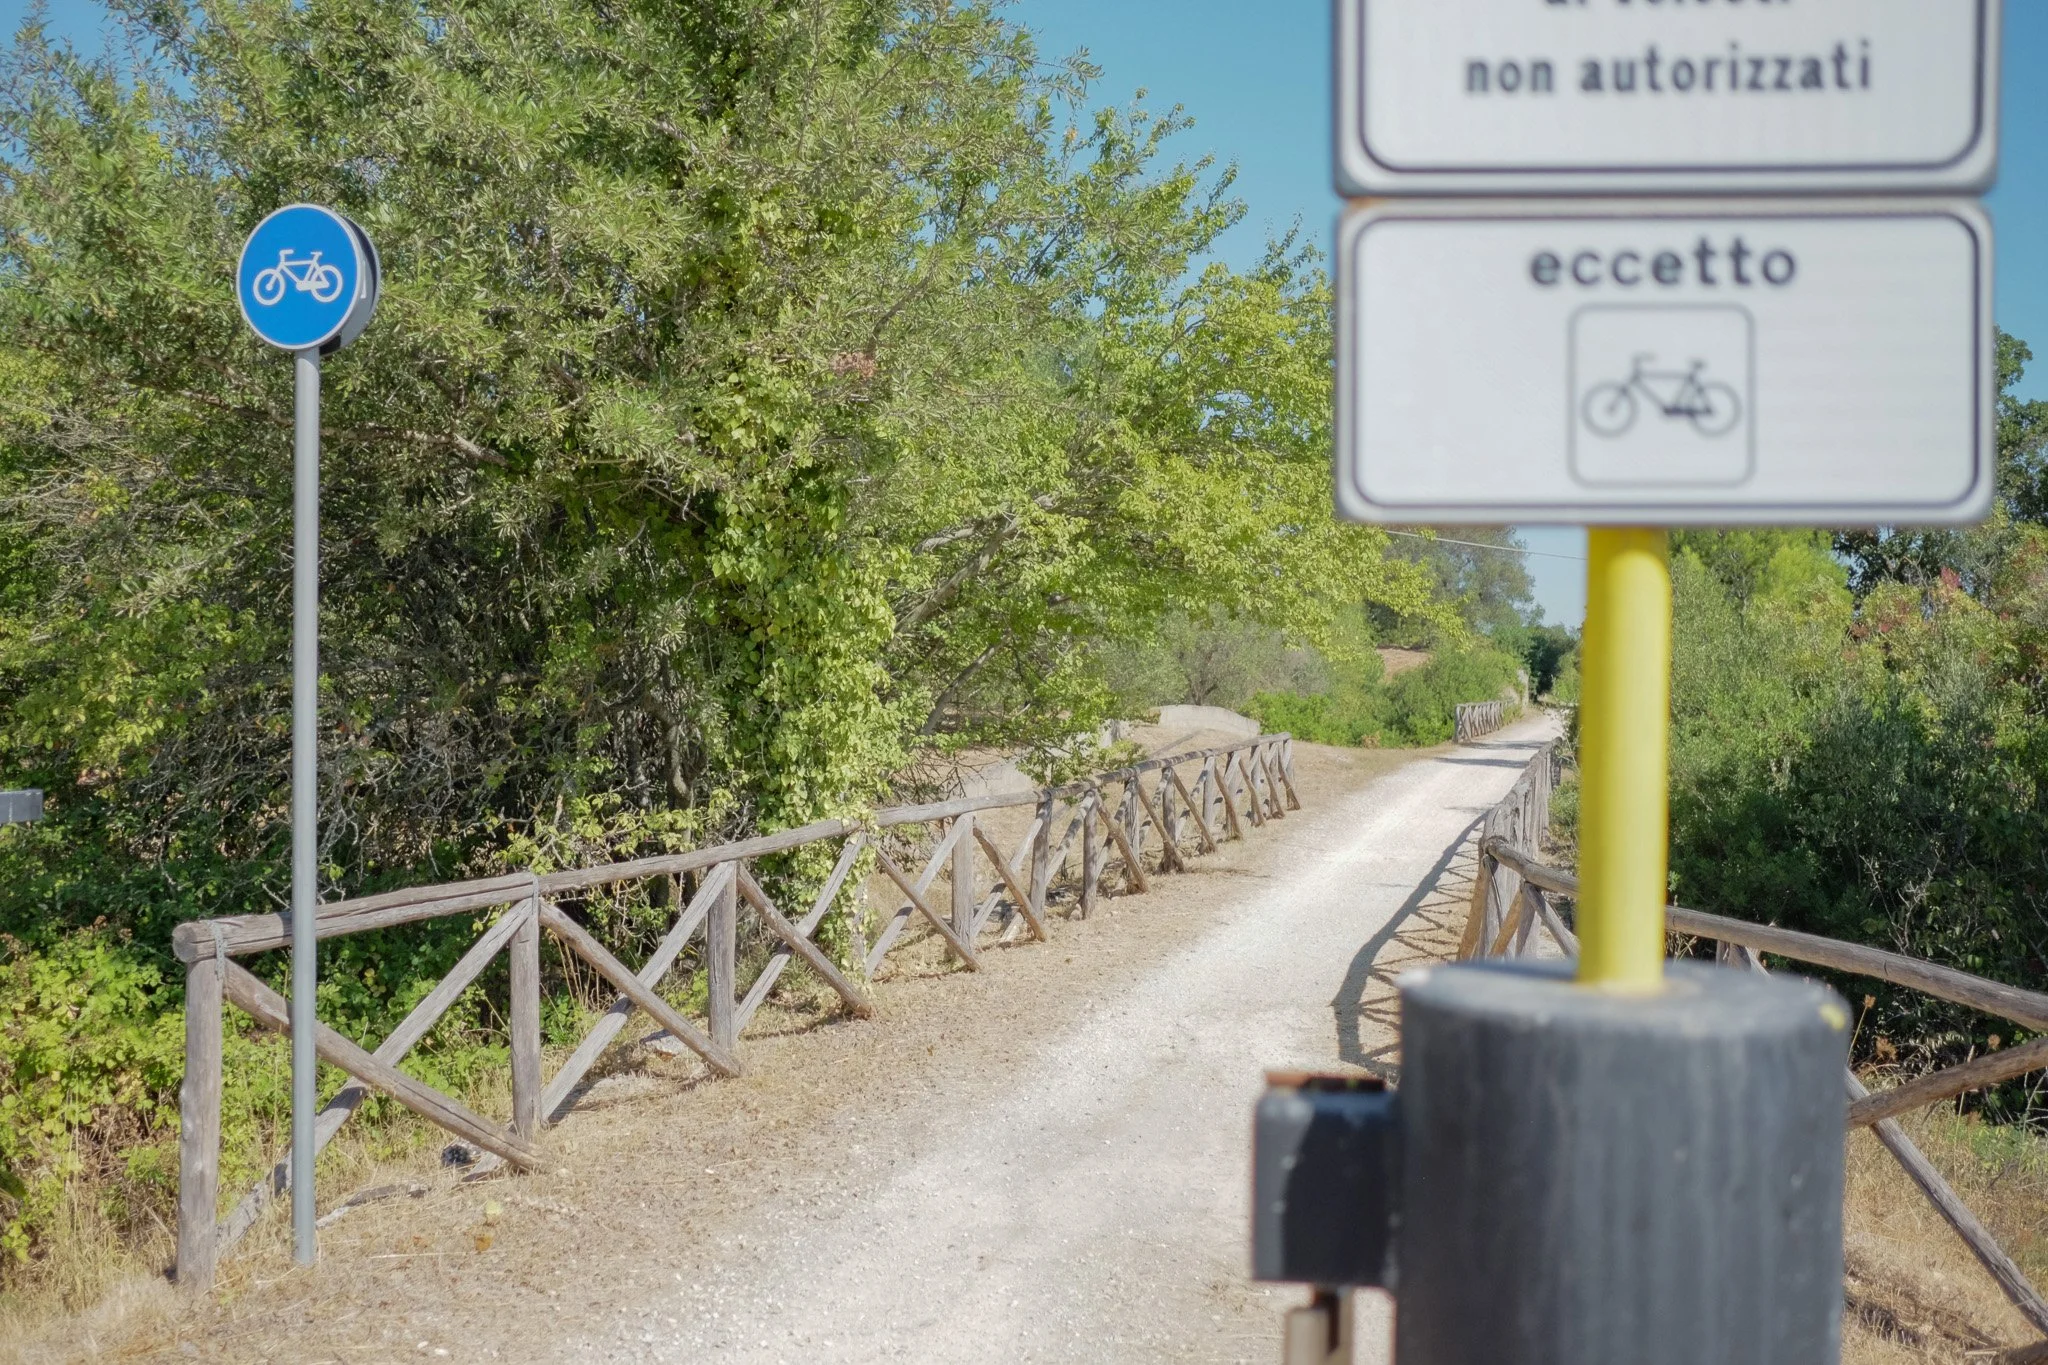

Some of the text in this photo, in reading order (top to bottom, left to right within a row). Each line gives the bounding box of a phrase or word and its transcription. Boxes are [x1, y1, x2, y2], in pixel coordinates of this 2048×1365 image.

[1464, 39, 1872, 95] non autorizzati
[1528, 235, 1798, 288] eccetto
